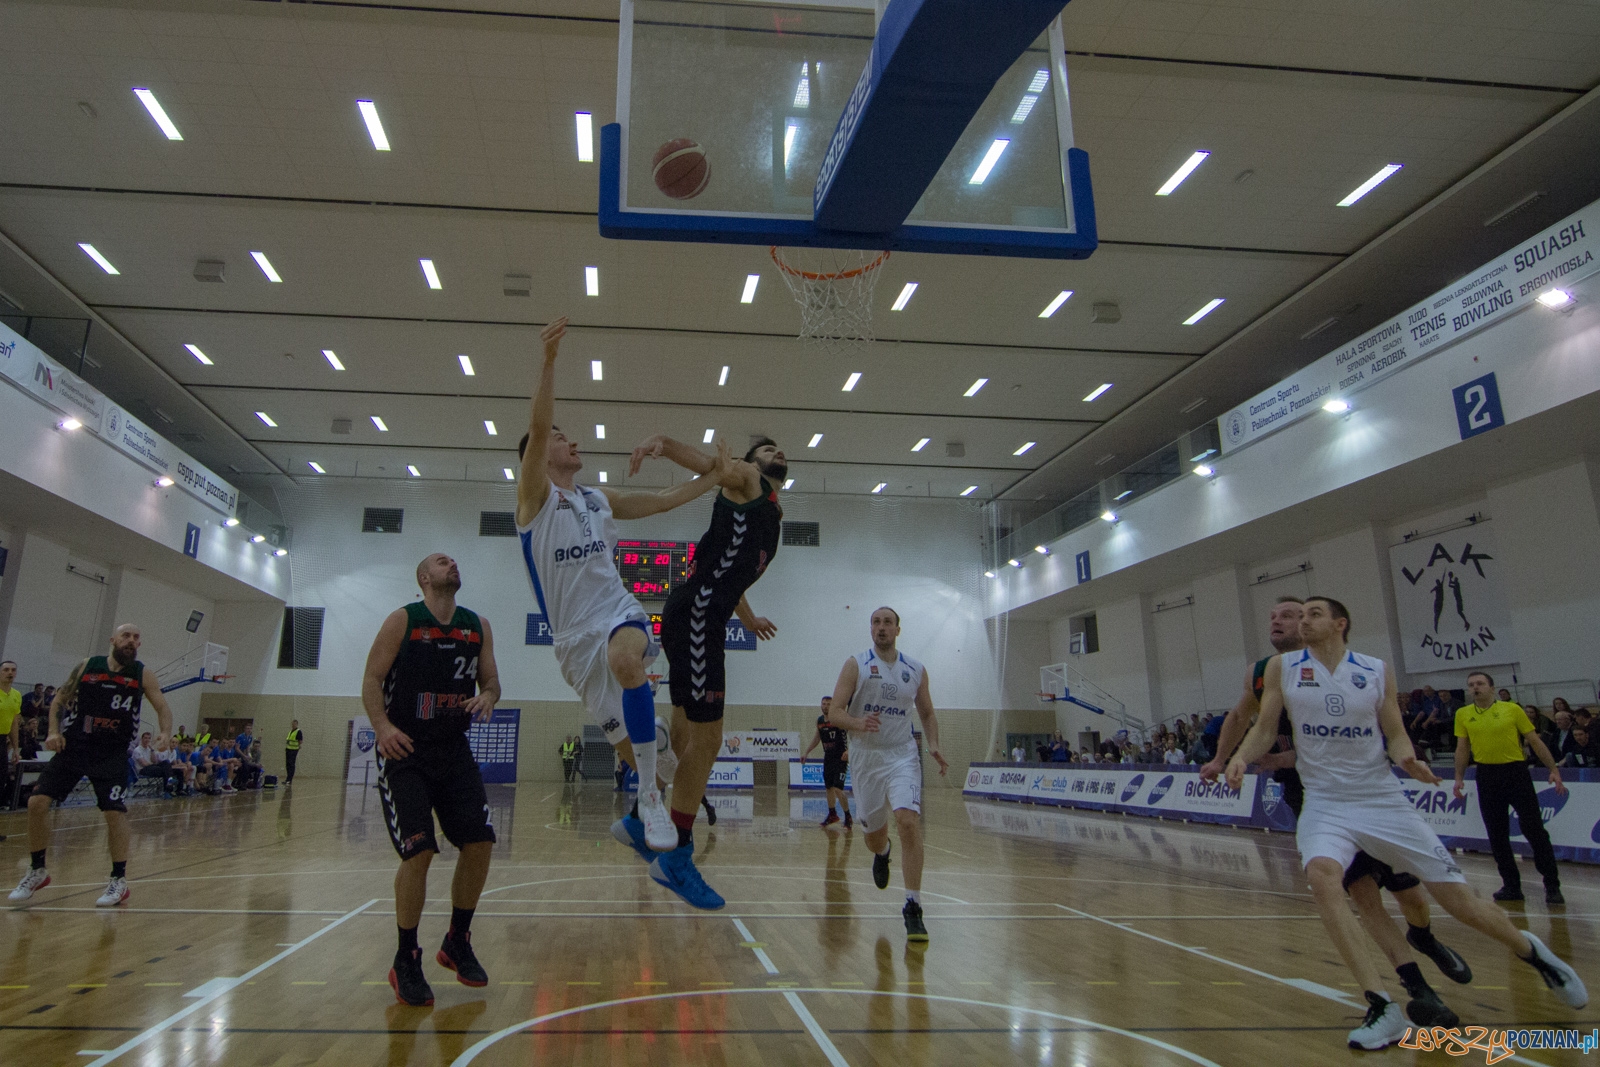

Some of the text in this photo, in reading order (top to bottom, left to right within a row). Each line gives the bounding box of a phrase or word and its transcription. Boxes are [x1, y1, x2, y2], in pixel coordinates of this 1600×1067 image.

[1514, 220, 1586, 273] SQUASH
[1454, 264, 1508, 298] LEKKOATLETYCZNA
[1519, 250, 1594, 297] ERGOWIOSŁA
[1461, 280, 1504, 309] SIŁOWNIA
[1408, 308, 1428, 326] JUDO
[1452, 289, 1514, 332] BOWLING
[1410, 312, 1447, 341] TENIS
[1335, 322, 1402, 366] HALA SPORTOWA
[1382, 336, 1403, 353] SZACHY
[1419, 333, 1440, 349] KARATE
[1371, 347, 1407, 375] AEROBIK
[1339, 370, 1365, 391] BOISKA
[1249, 383, 1300, 417] Centrum Sportu
[1251, 383, 1333, 432] Politechniki Poznańskiej
[1464, 384, 1491, 430] 2
[123, 434, 148, 456] Politechniki
[125, 419, 157, 448] Centrum Sportu
[177, 461, 236, 510] cspp.put.poznan.pl
[189, 529, 196, 554] 1
[624, 554, 639, 564] 33
[655, 555, 670, 565] 20
[1079, 555, 1086, 579] 1
[1401, 542, 1493, 586] LAK
[1421, 626, 1495, 660] POZNAŃ
[453, 656, 479, 679] 24
[110, 694, 133, 711] 84
[881, 683, 898, 701] 12
[864, 703, 906, 717] BIOFARM
[1325, 693, 1345, 717] 8
[753, 737, 788, 746] MAXXX
[829, 731, 836, 739] 17
[1302, 723, 1373, 739] BIOFARM
[1000, 772, 1026, 785] BIOFARM
[1184, 780, 1241, 800] BIOFARM
